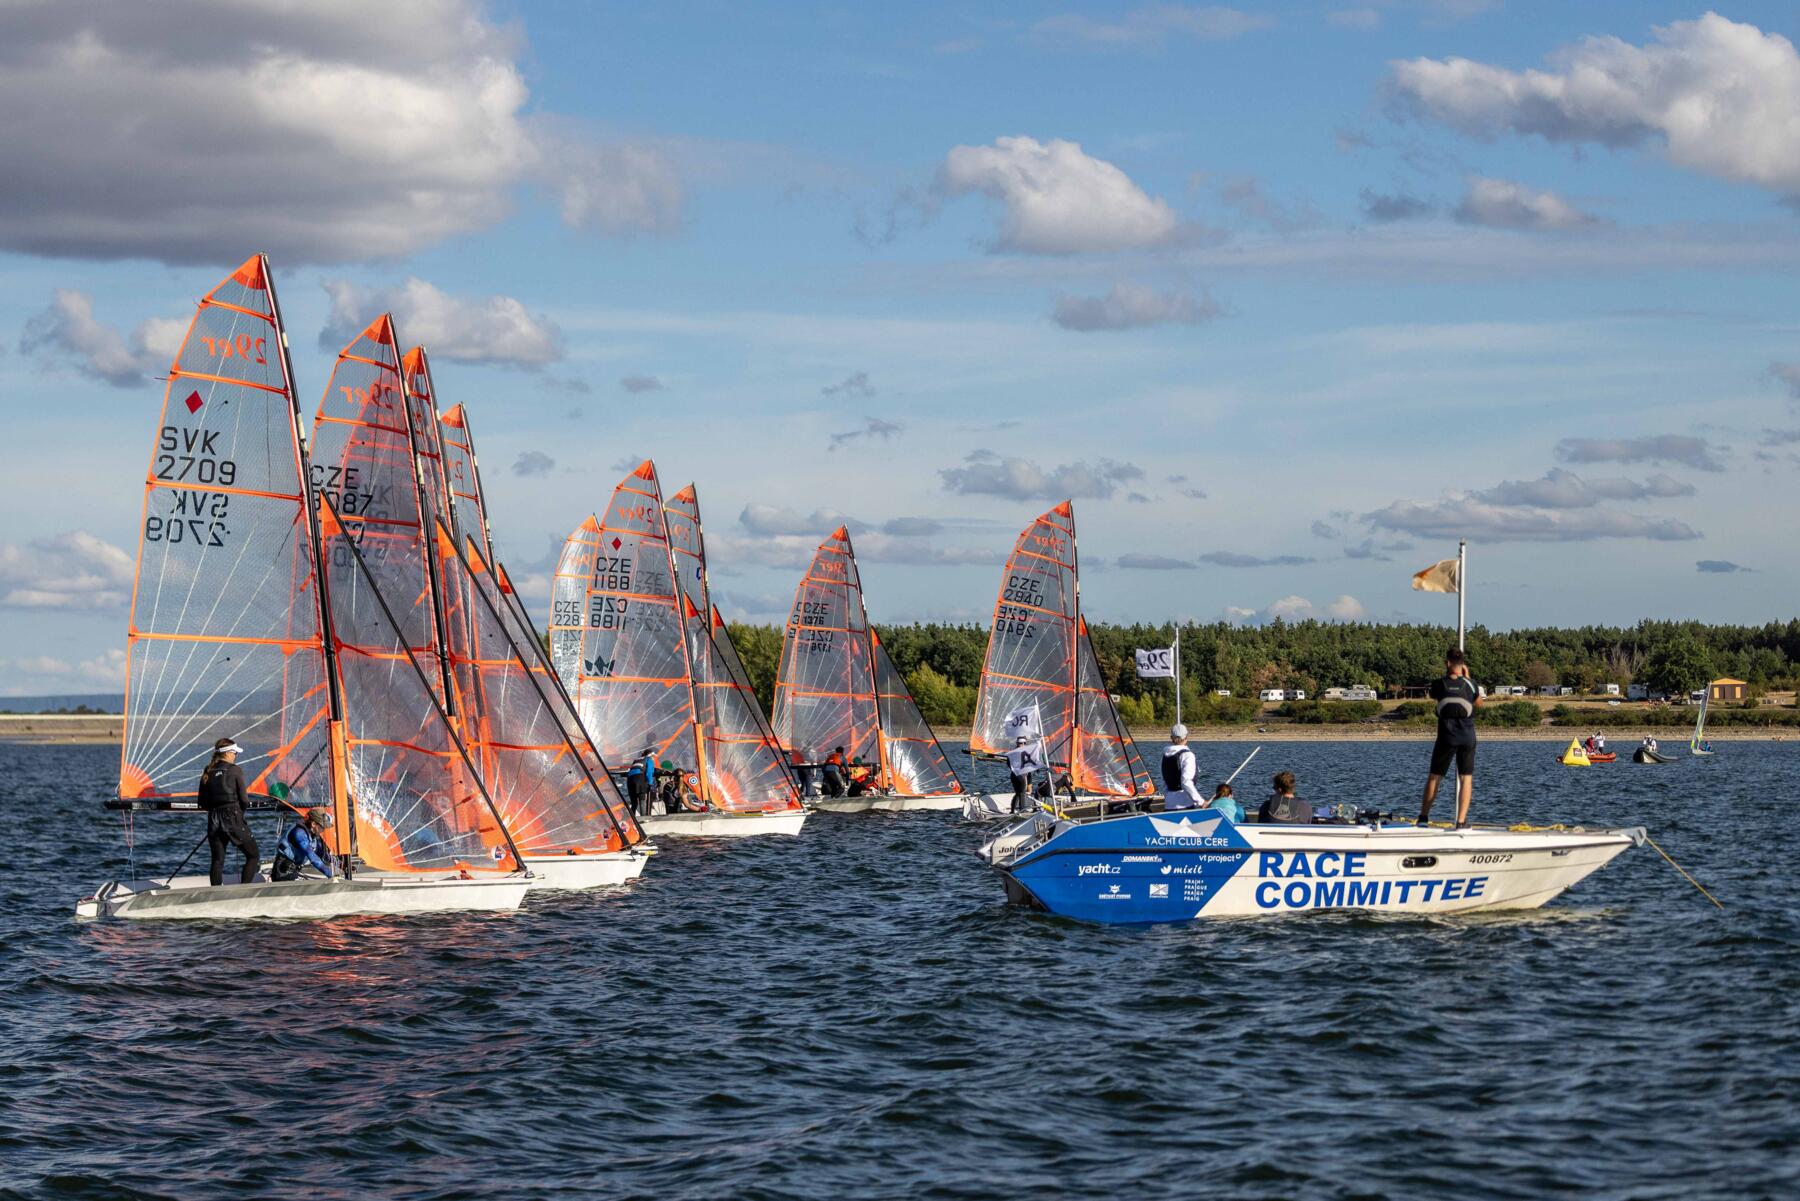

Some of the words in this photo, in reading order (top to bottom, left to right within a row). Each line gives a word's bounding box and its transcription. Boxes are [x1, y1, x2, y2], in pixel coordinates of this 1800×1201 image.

[161, 426, 220, 455] SVK
[157, 454, 236, 486] 2709
[311, 465, 359, 490] CZE
[596, 557, 631, 574] CZE
[593, 573, 630, 590] 1188
[1009, 576, 1040, 592] CZE
[554, 601, 580, 613] CZE
[803, 602, 829, 614] CZE
[1145, 837, 1176, 846] YACHT
[1178, 838, 1202, 846] CLUB
[1204, 838, 1229, 847] CERE
[1207, 854, 1235, 863] project
[1258, 852, 1367, 878] RACE
[1469, 854, 1514, 864] 400872
[1078, 863, 1121, 876] yacht.cz
[1173, 865, 1203, 874] mixit
[1255, 876, 1488, 909] COMMITTEE
